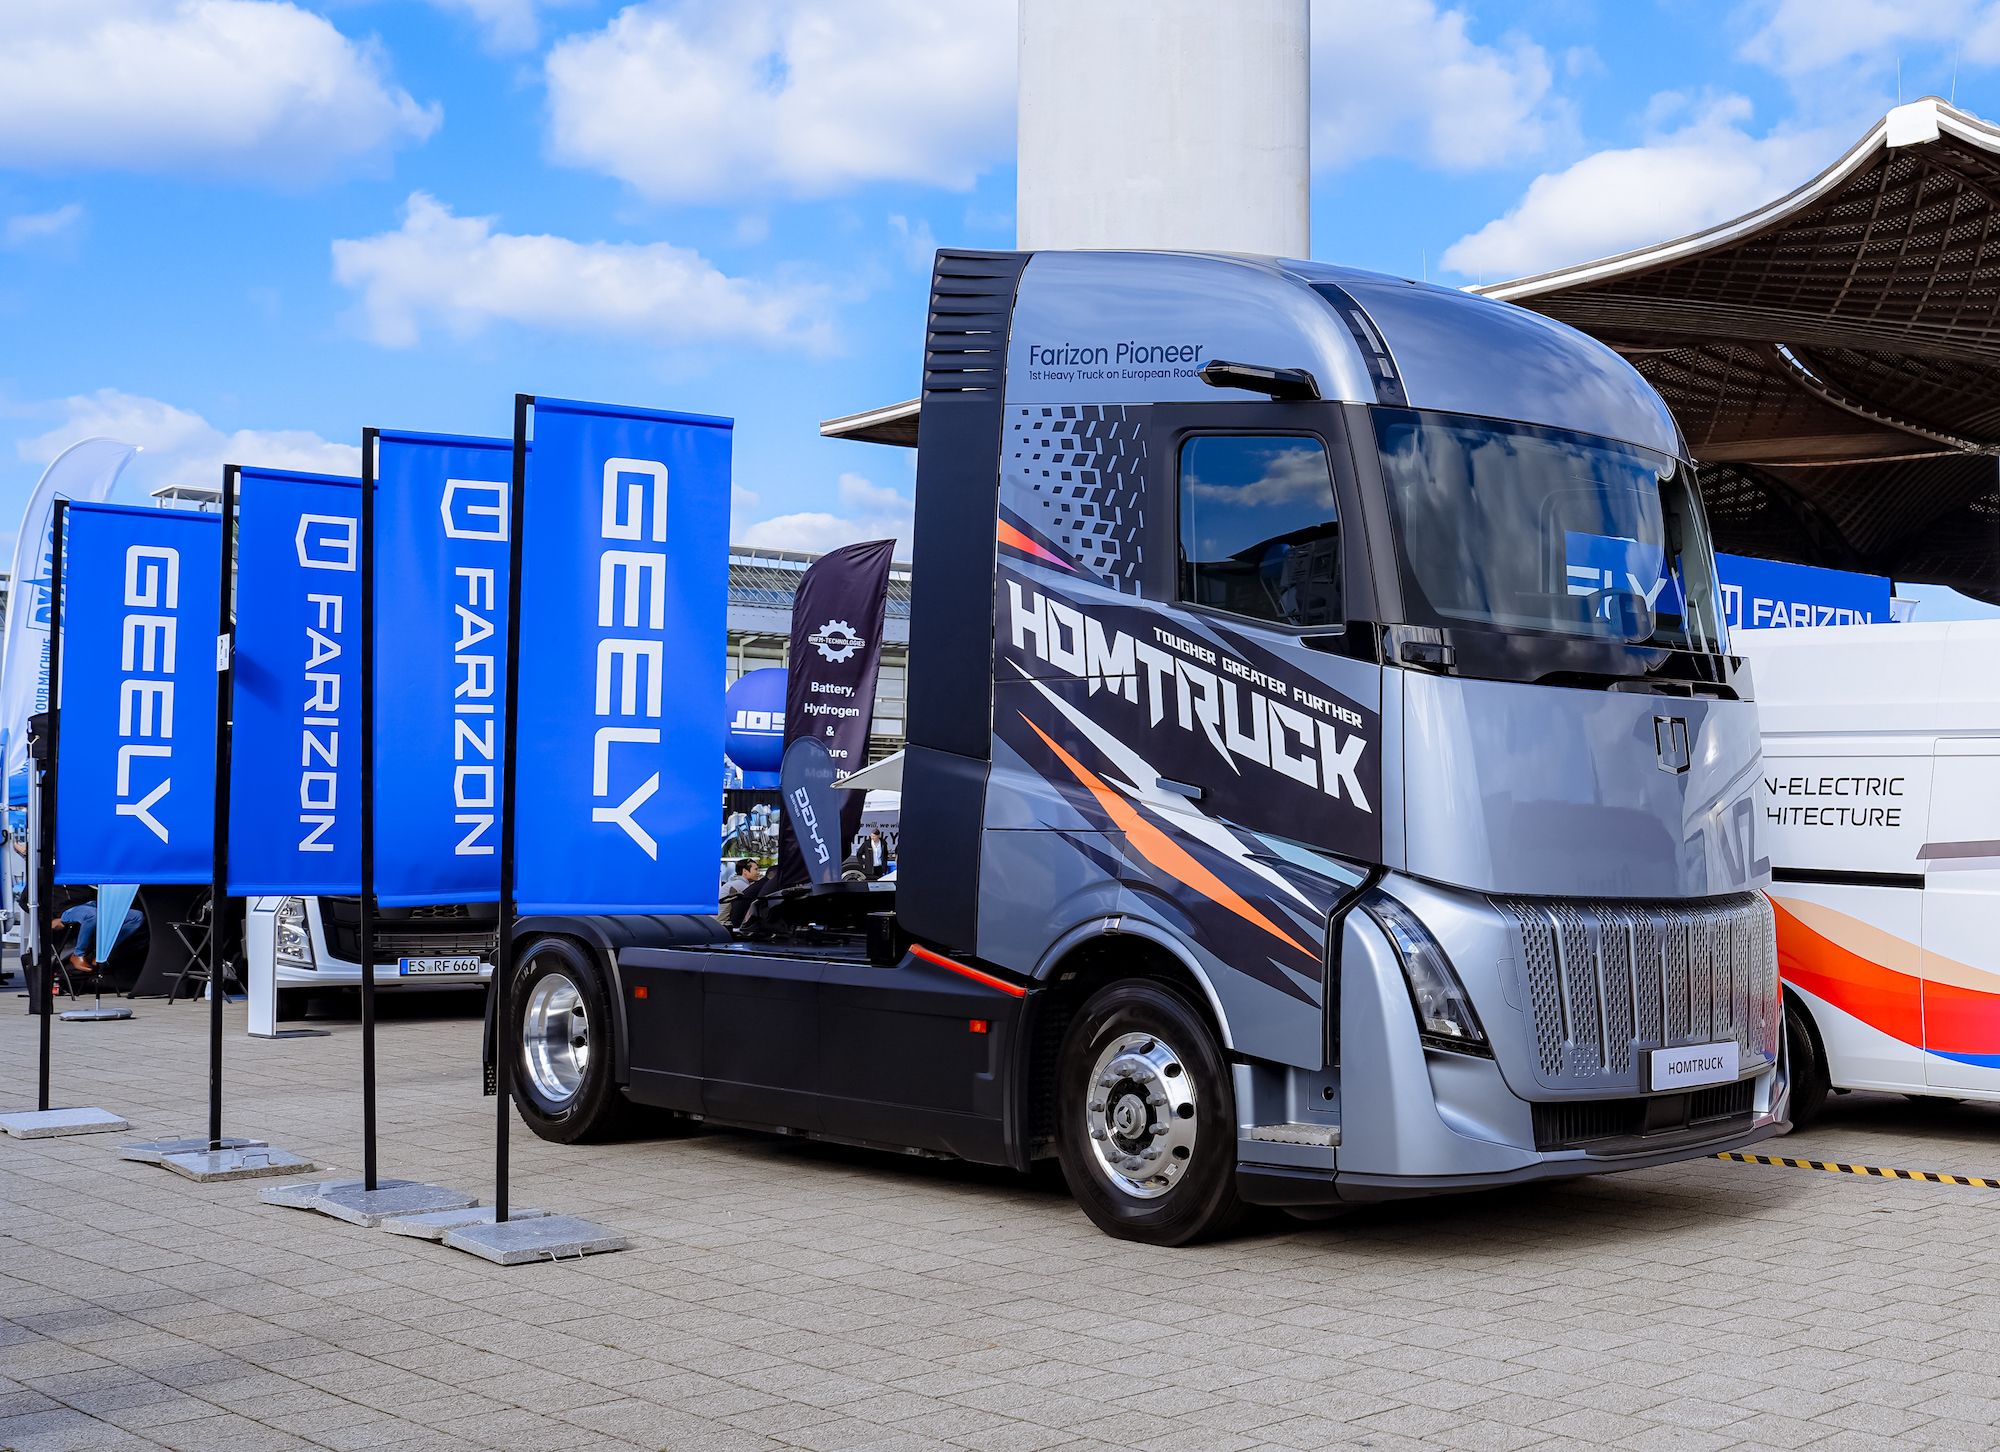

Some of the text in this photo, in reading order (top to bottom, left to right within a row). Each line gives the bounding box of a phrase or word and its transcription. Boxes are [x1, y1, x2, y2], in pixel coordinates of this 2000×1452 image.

[1029, 340, 1204, 366] Farizon Pioneer
[1029, 370, 1042, 380] 1st
[1043, 370, 1075, 383] Heavy
[1077, 369, 1104, 380] Truck
[1106, 371, 1119, 379] on
[1121, 368, 1171, 382] European
[591, 457, 668, 861] GEELY
[810, 681, 856, 698] Battery,
[1153, 626, 1364, 730] TOUGHER GREATER FURTHER
[116, 545, 180, 845] GEELY
[1005, 579, 1373, 814] HOMTRUCK
[454, 567, 495, 856] FARIZON
[804, 702, 860, 719] Hydrogen
[299, 594, 343, 852] FARIZON
[825, 725, 835, 737] &
[1766, 807, 1901, 826] HITECTURE
[408, 960, 477, 973] ES RF 666
[1668, 1056, 1724, 1076] HOMTRUCK
